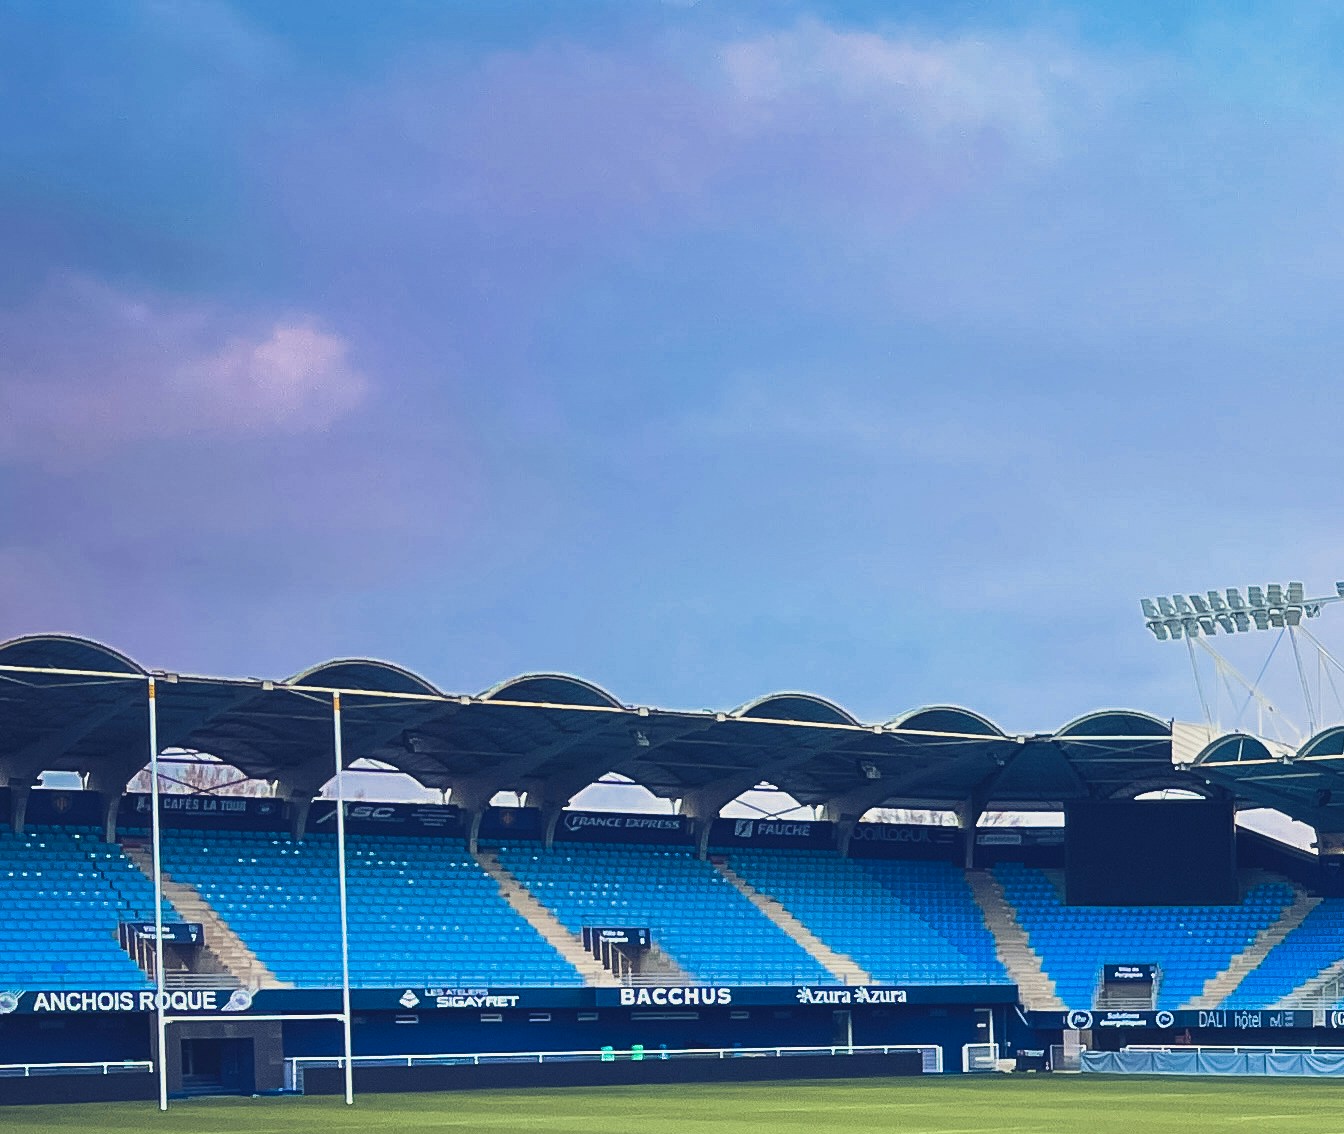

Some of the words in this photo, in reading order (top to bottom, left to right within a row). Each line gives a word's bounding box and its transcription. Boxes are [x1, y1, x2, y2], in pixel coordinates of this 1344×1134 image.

[204, 799, 217, 810] LA
[572, 816, 622, 828] FRANCE
[625, 819, 680, 831] EXPRESS
[424, 988, 444, 996] LES
[620, 987, 732, 1006] BACCHUS
[805, 987, 851, 1004] Azura
[862, 987, 907, 1004] Azura
[33, 991, 133, 1012] ANCHOIS
[139, 991, 218, 1011] ROQUE
[436, 995, 520, 1008] SIGAYRET
[1234, 1010, 1262, 1029] hôtel
